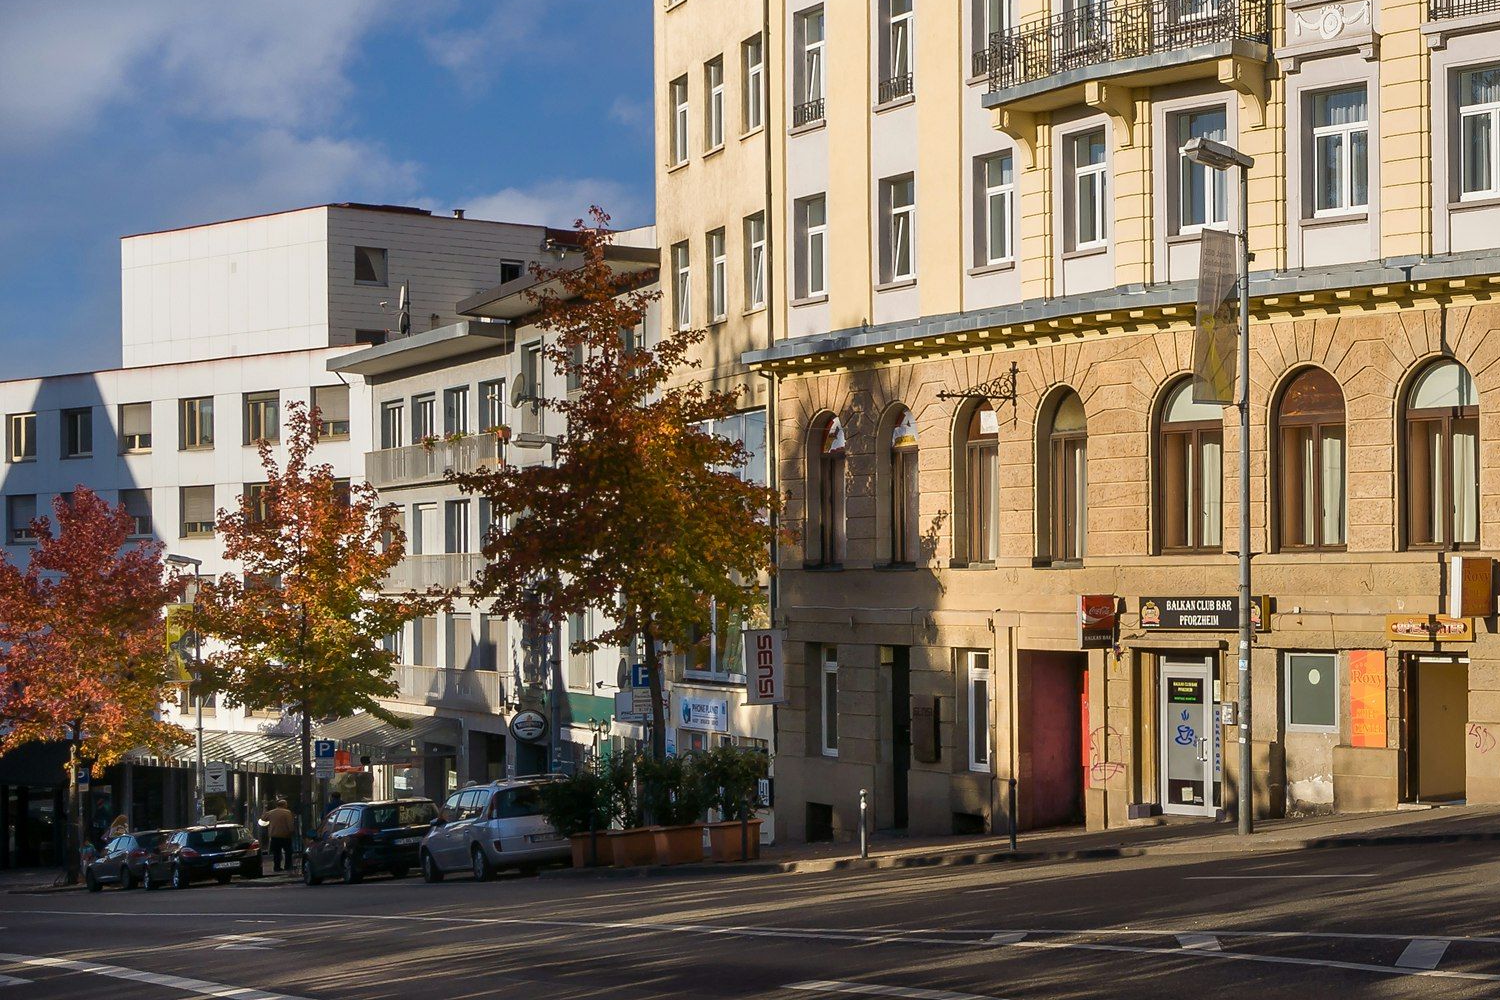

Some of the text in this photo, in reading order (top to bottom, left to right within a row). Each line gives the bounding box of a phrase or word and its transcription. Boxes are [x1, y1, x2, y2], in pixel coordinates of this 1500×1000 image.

[1166, 600, 1232, 612] BALKAN CLUB BAR
[1179, 614, 1219, 626] PFORZHEIM
[757, 634, 774, 698] SENSI
[1352, 670, 1384, 688] Roxy
[319, 742, 331, 757] P
